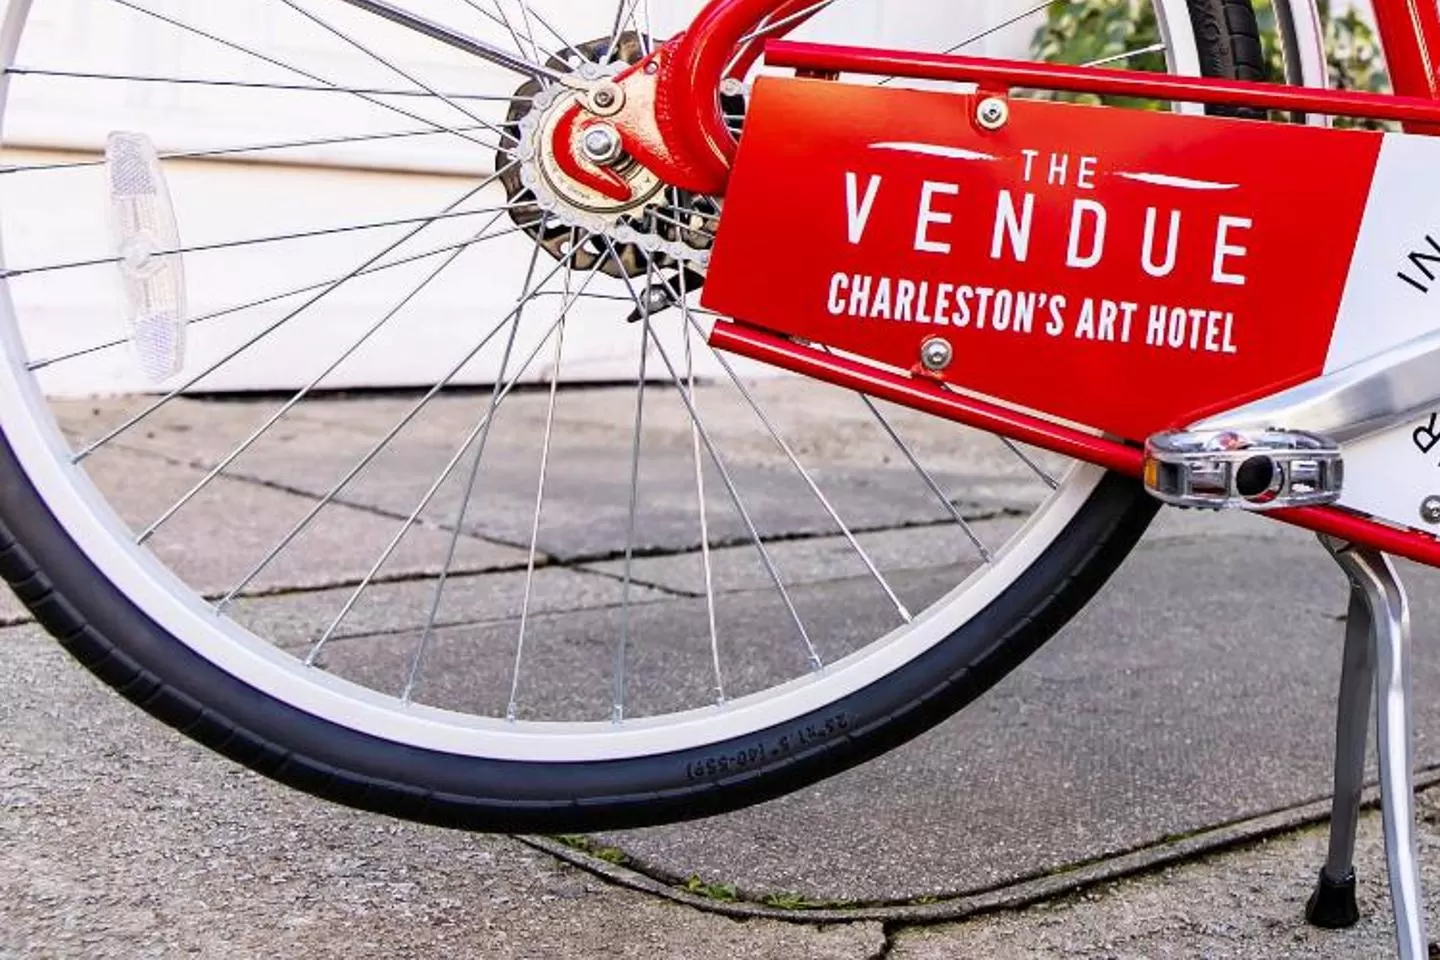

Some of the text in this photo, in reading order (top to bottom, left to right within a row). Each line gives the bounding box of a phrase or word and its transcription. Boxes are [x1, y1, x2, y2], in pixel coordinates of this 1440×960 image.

[1019, 149, 1097, 189] THE
[843, 171, 1253, 285] VENDUE
[827, 272, 1237, 354] CHARLESTON'S ART HOTEL
